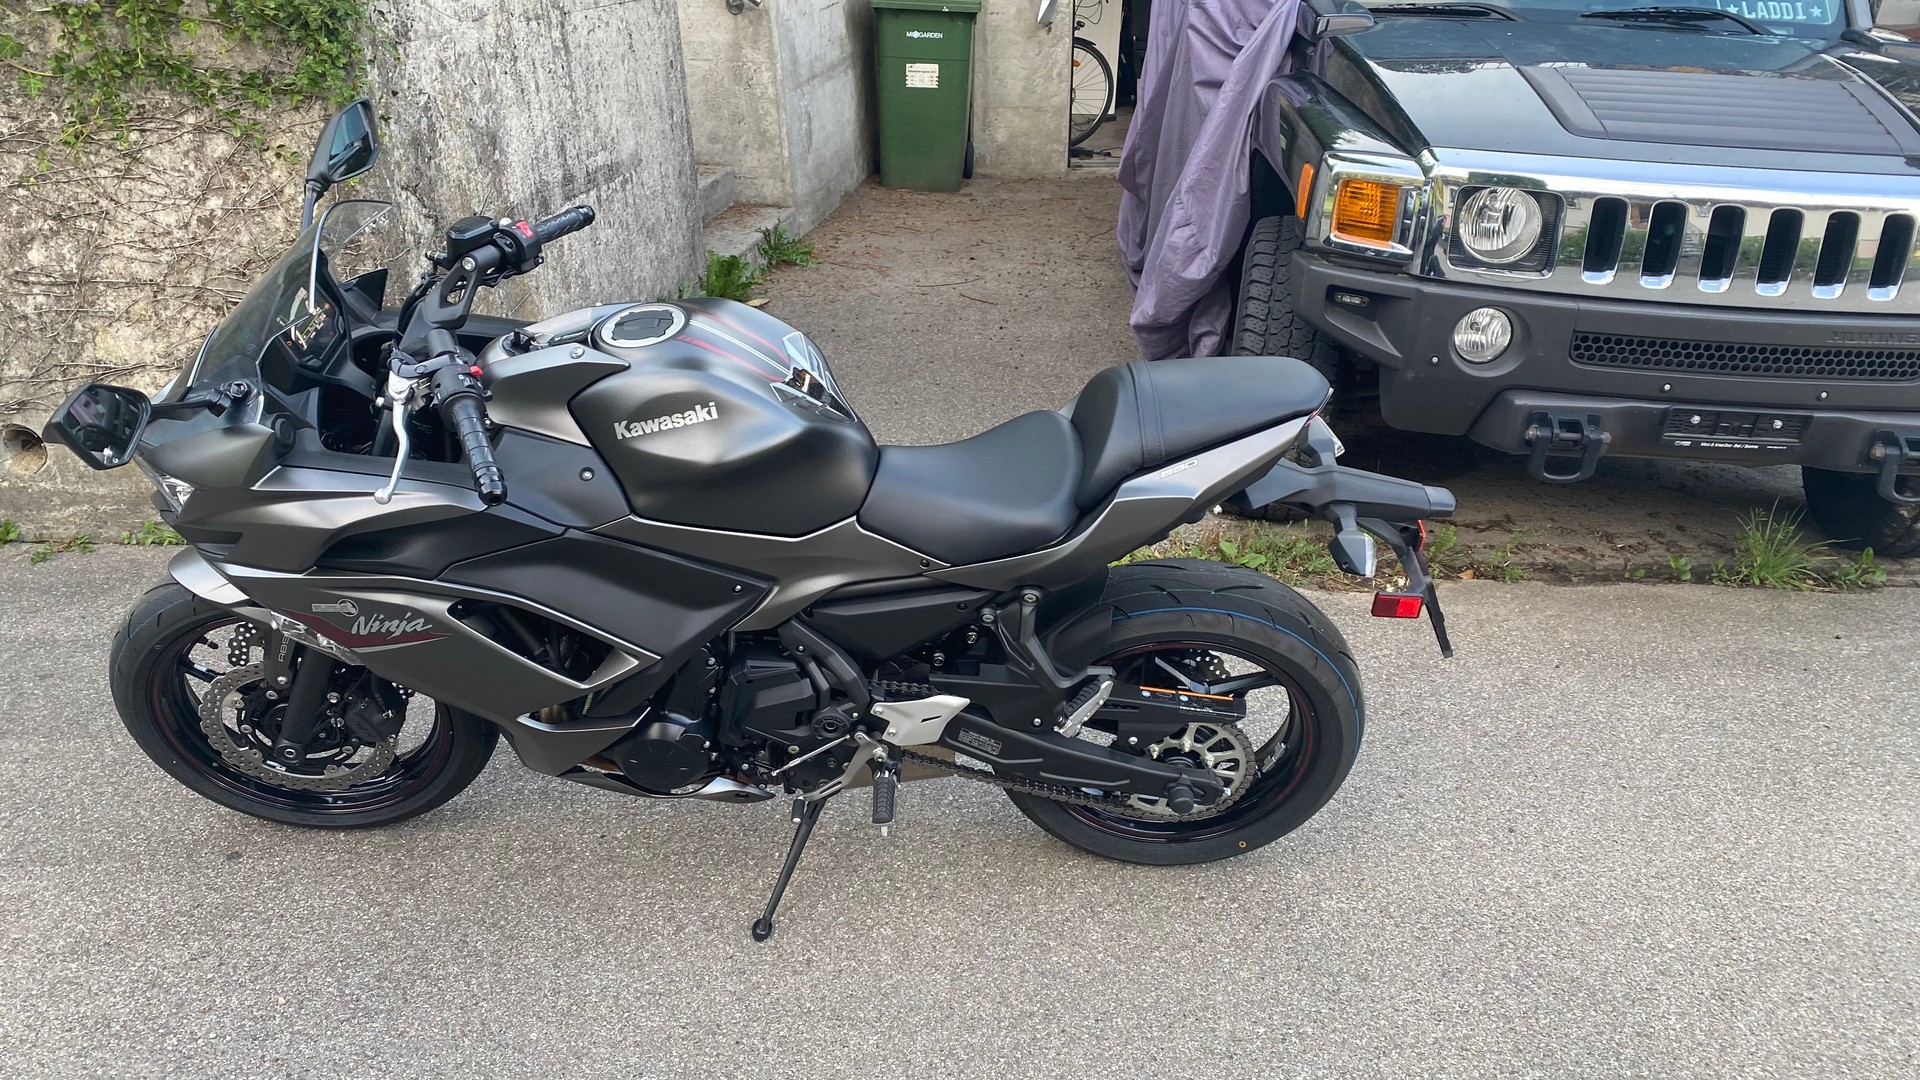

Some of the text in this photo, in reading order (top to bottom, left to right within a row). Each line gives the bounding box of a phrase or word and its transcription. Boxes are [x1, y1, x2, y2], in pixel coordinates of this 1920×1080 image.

[1741, 1, 1807, 20] LADDI
[613, 401, 719, 440] Kawasaki
[351, 611, 433, 640] Ninja
